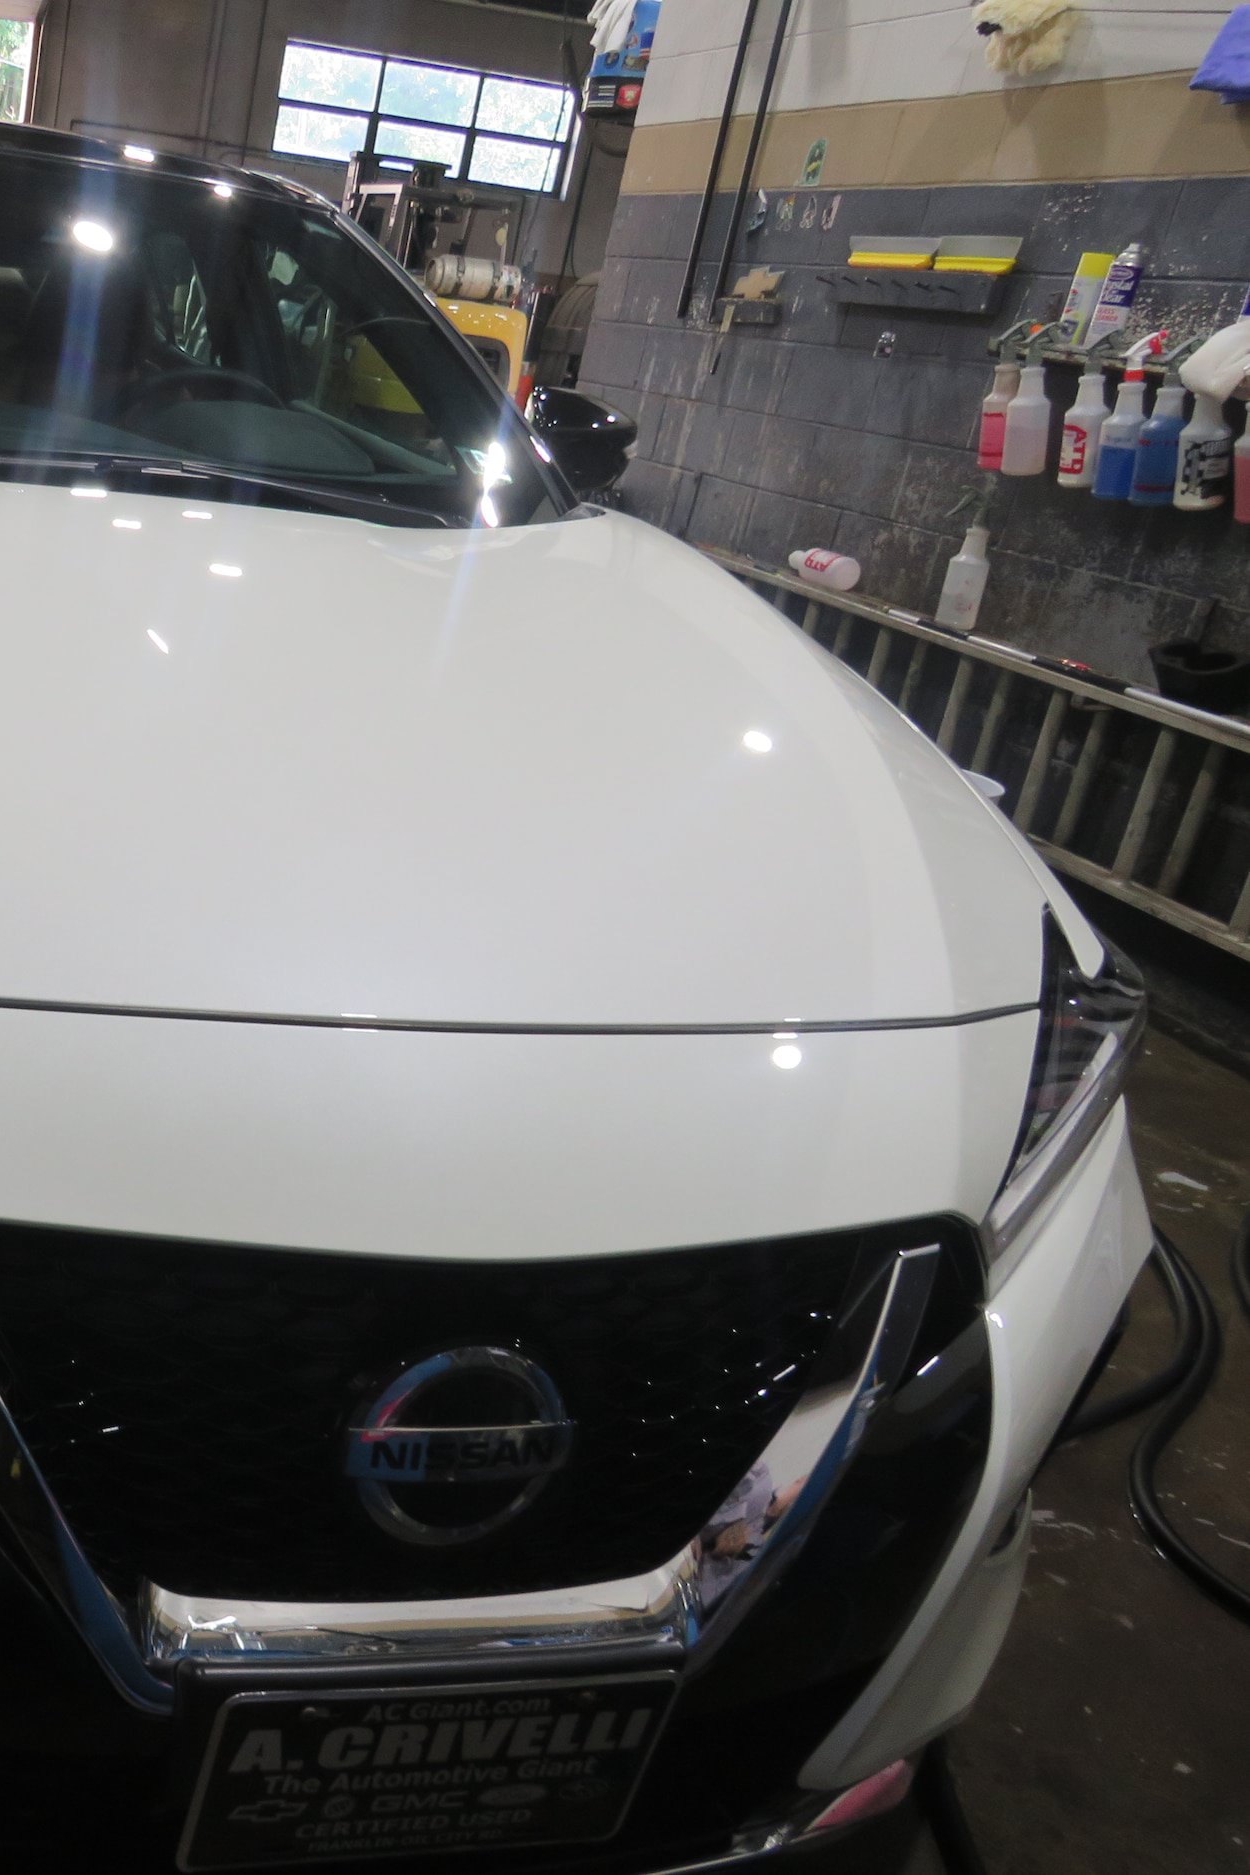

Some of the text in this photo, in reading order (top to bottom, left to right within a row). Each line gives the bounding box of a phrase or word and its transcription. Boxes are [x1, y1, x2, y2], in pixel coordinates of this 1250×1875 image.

[370, 1438, 553, 1471] NISSAN
[364, 1697, 550, 1722] AC Giant.com
[229, 1708, 653, 1773] A. CRIVELLI
[265, 1758, 596, 1795] The Automotive Giant
[371, 1791, 468, 1812] GMC
[295, 1809, 531, 1838] CERTIFIED USED
